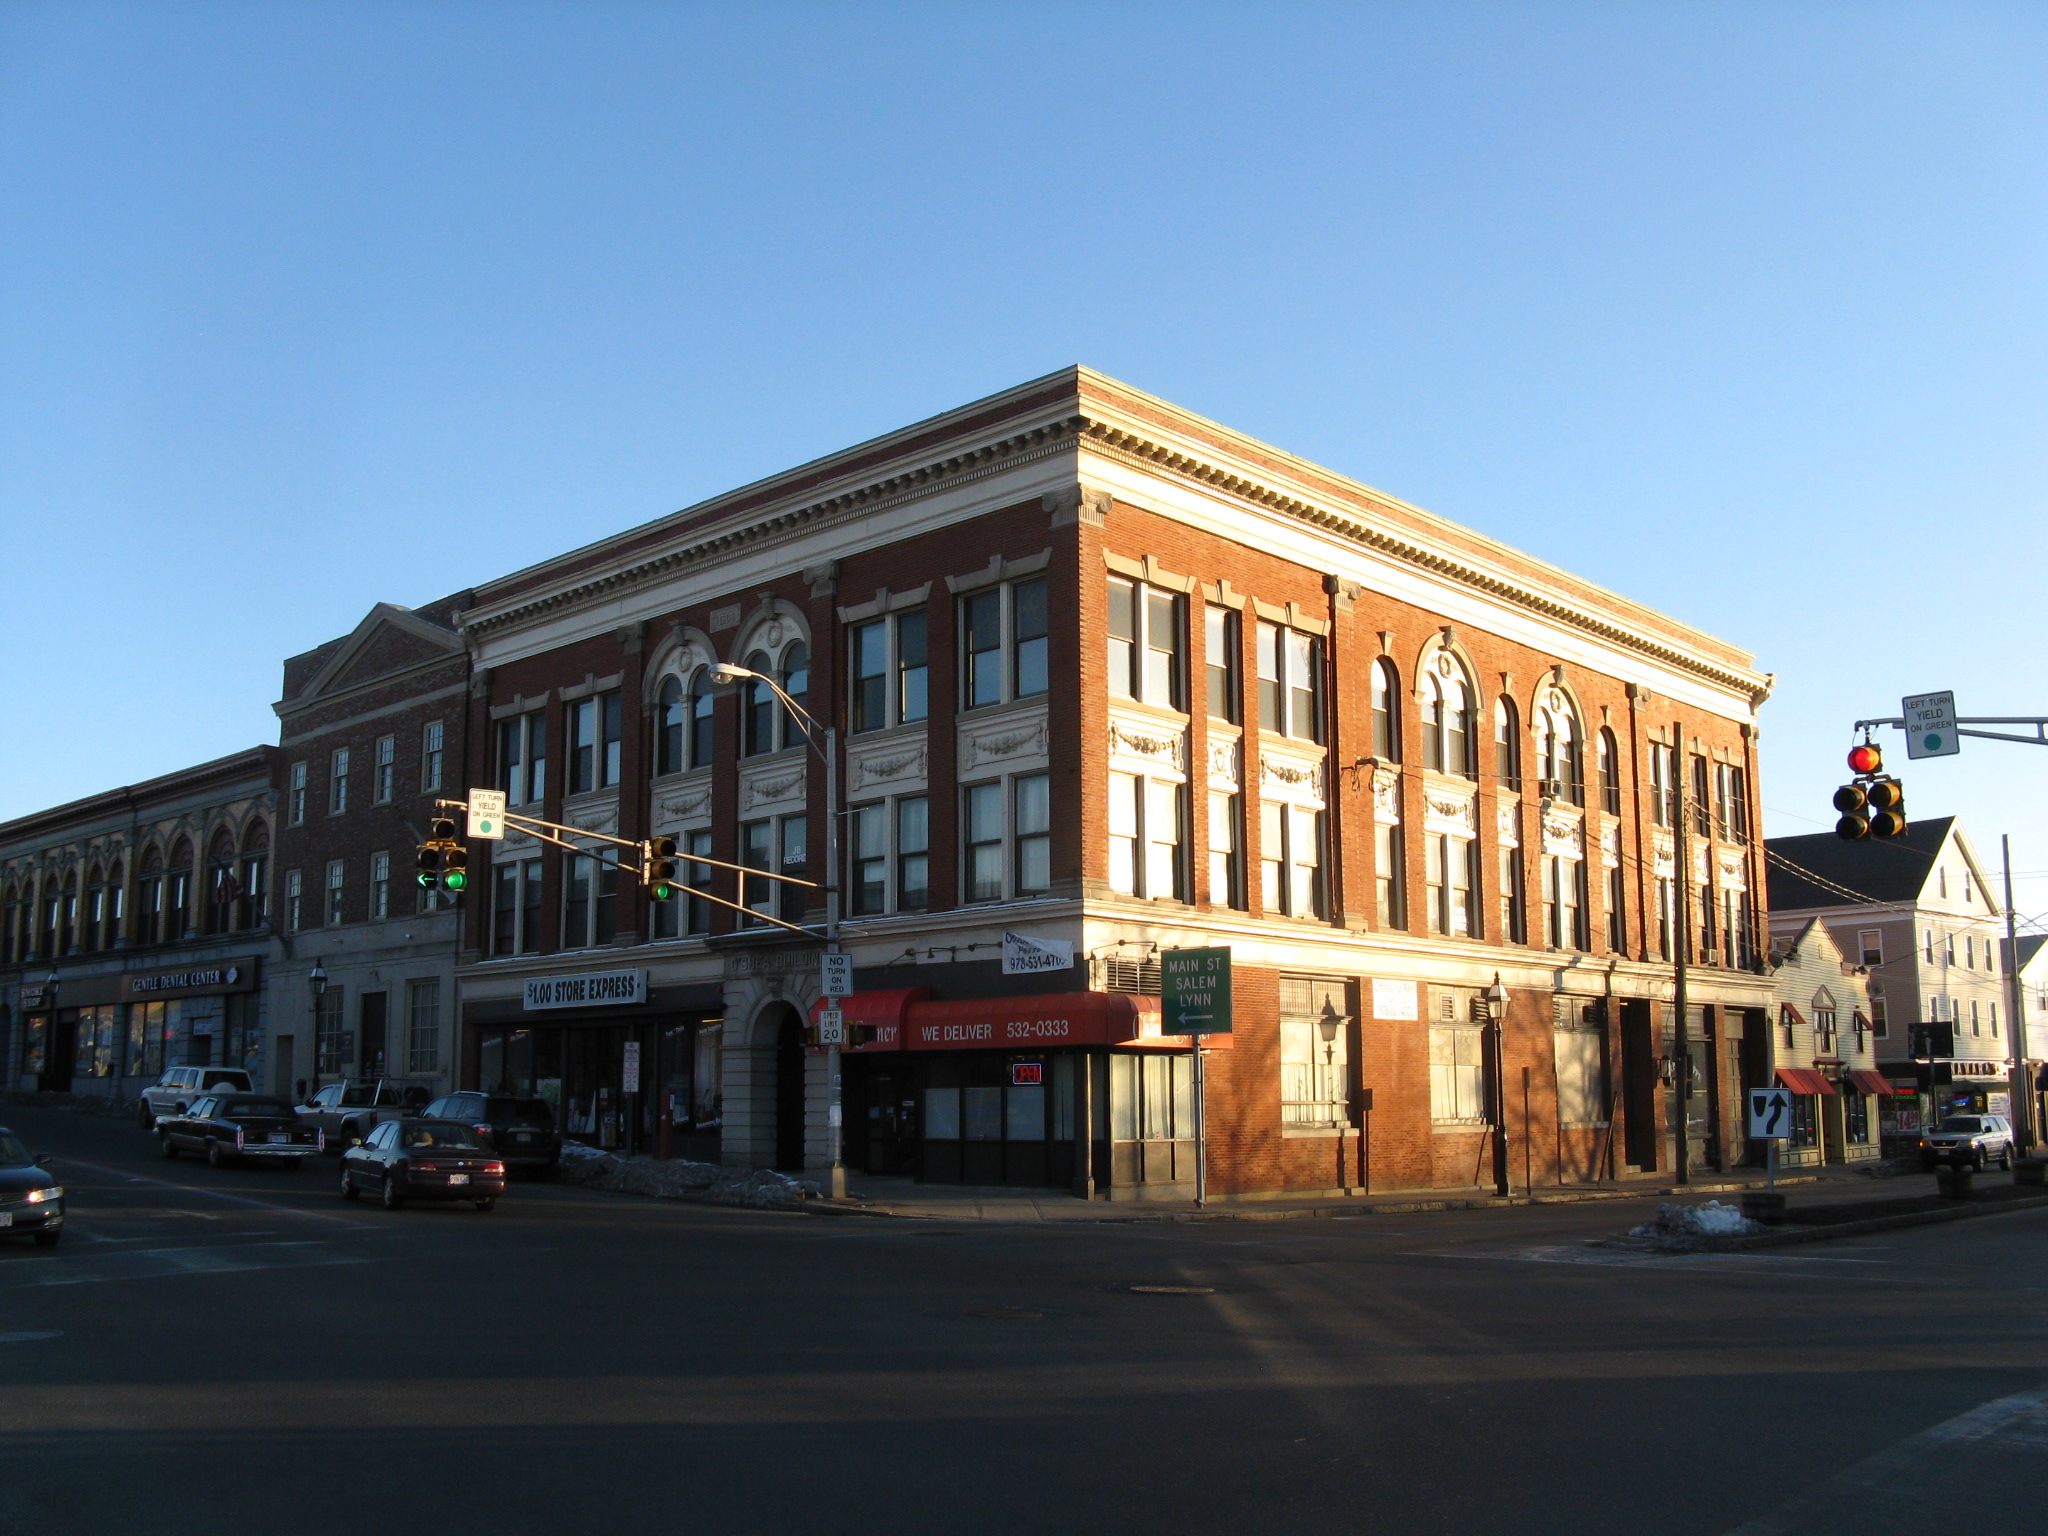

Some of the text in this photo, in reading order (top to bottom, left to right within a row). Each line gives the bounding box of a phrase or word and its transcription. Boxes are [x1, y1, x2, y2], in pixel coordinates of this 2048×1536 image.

[1906, 696, 1951, 709] LEFT TURN
[1917, 709, 1943, 720] YIELD
[1911, 720, 1952, 733] ON GREEN
[478, 802, 497, 811] YIELD
[776, 952, 820, 968] BUILDIN
[829, 957, 844, 966] NO
[1169, 959, 1199, 973] MAIN
[827, 967, 846, 975] TURN
[132, 970, 221, 992] GENTLE DENTAL CENTER
[831, 976, 842, 984] ON
[1175, 975, 1216, 990] SALEM
[528, 975, 635, 1004] $1.00 STORE EXPRESS
[830, 985, 844, 993] RED
[1180, 993, 1211, 1007] LYNN
[823, 1029, 839, 1040] 20
[922, 1019, 1069, 1041] WE DELIVER 532-0333
[1015, 1065, 1041, 1083] OPEN
